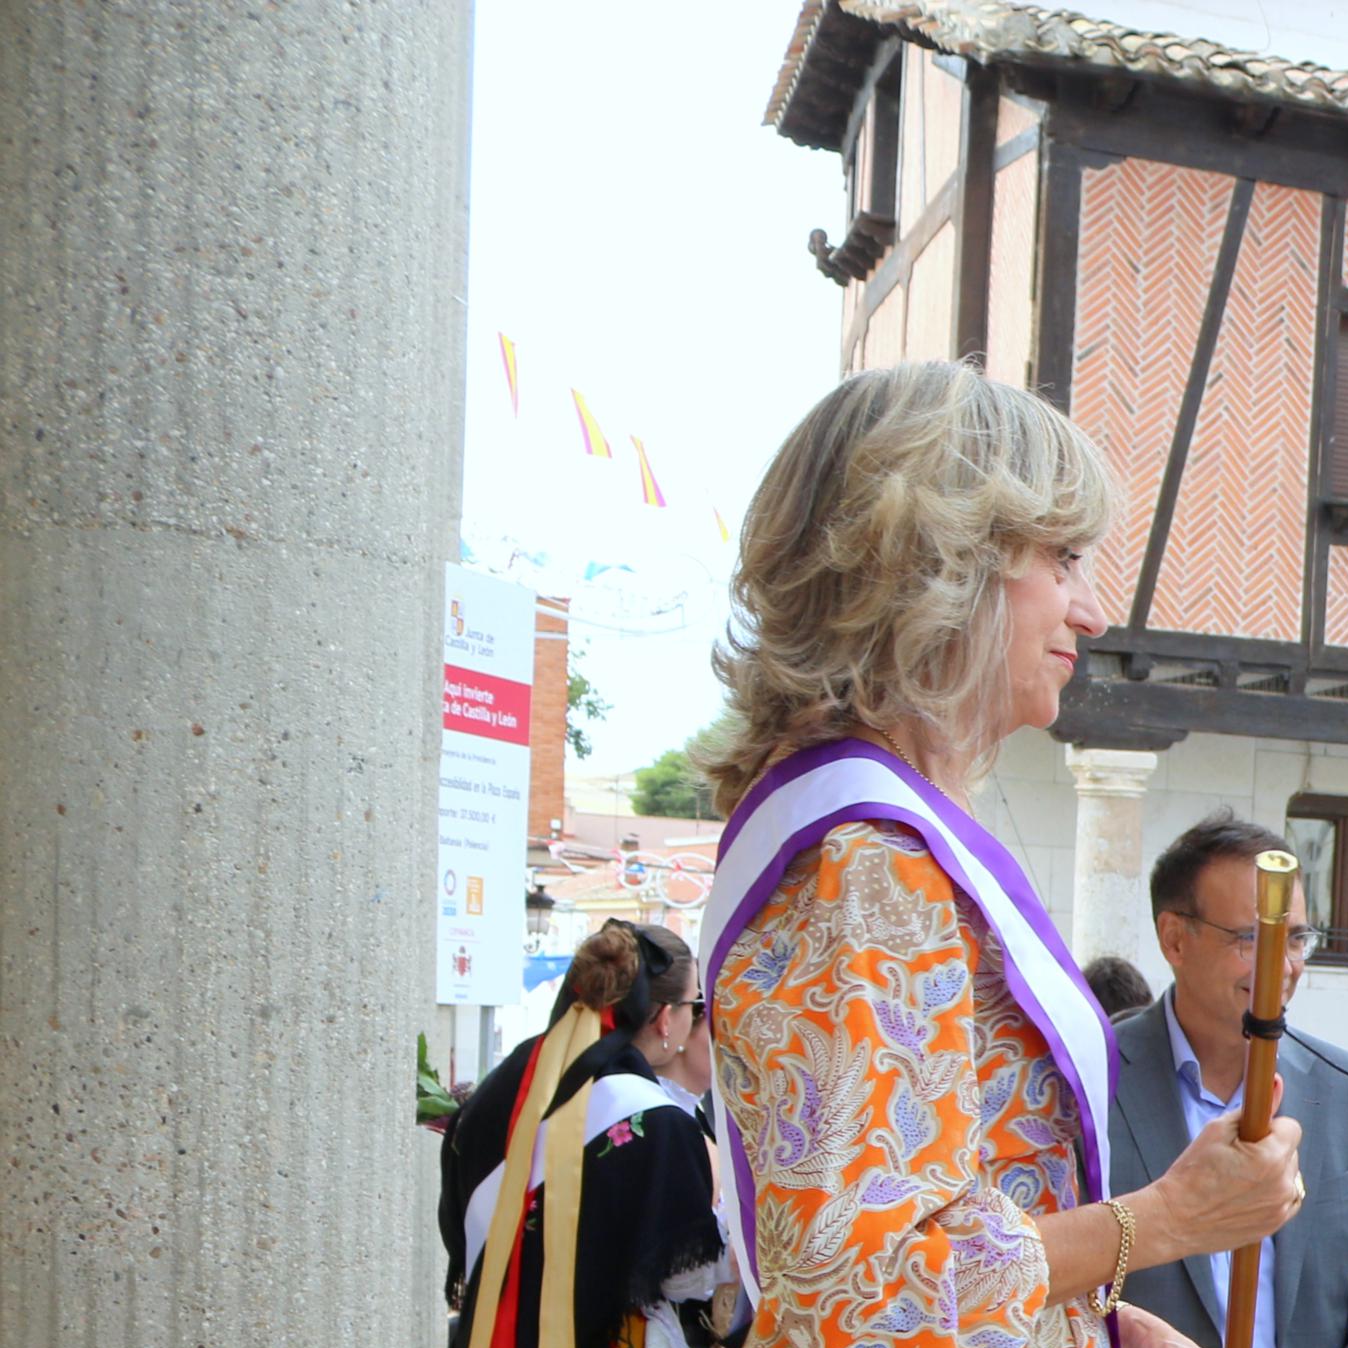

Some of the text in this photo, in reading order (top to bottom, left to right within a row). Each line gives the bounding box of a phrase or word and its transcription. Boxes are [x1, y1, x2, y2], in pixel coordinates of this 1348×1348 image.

[462, 683, 494, 704] invierte
[450, 700, 462, 716] de
[462, 702, 491, 722] Castilla
[498, 710, 518, 728] León
